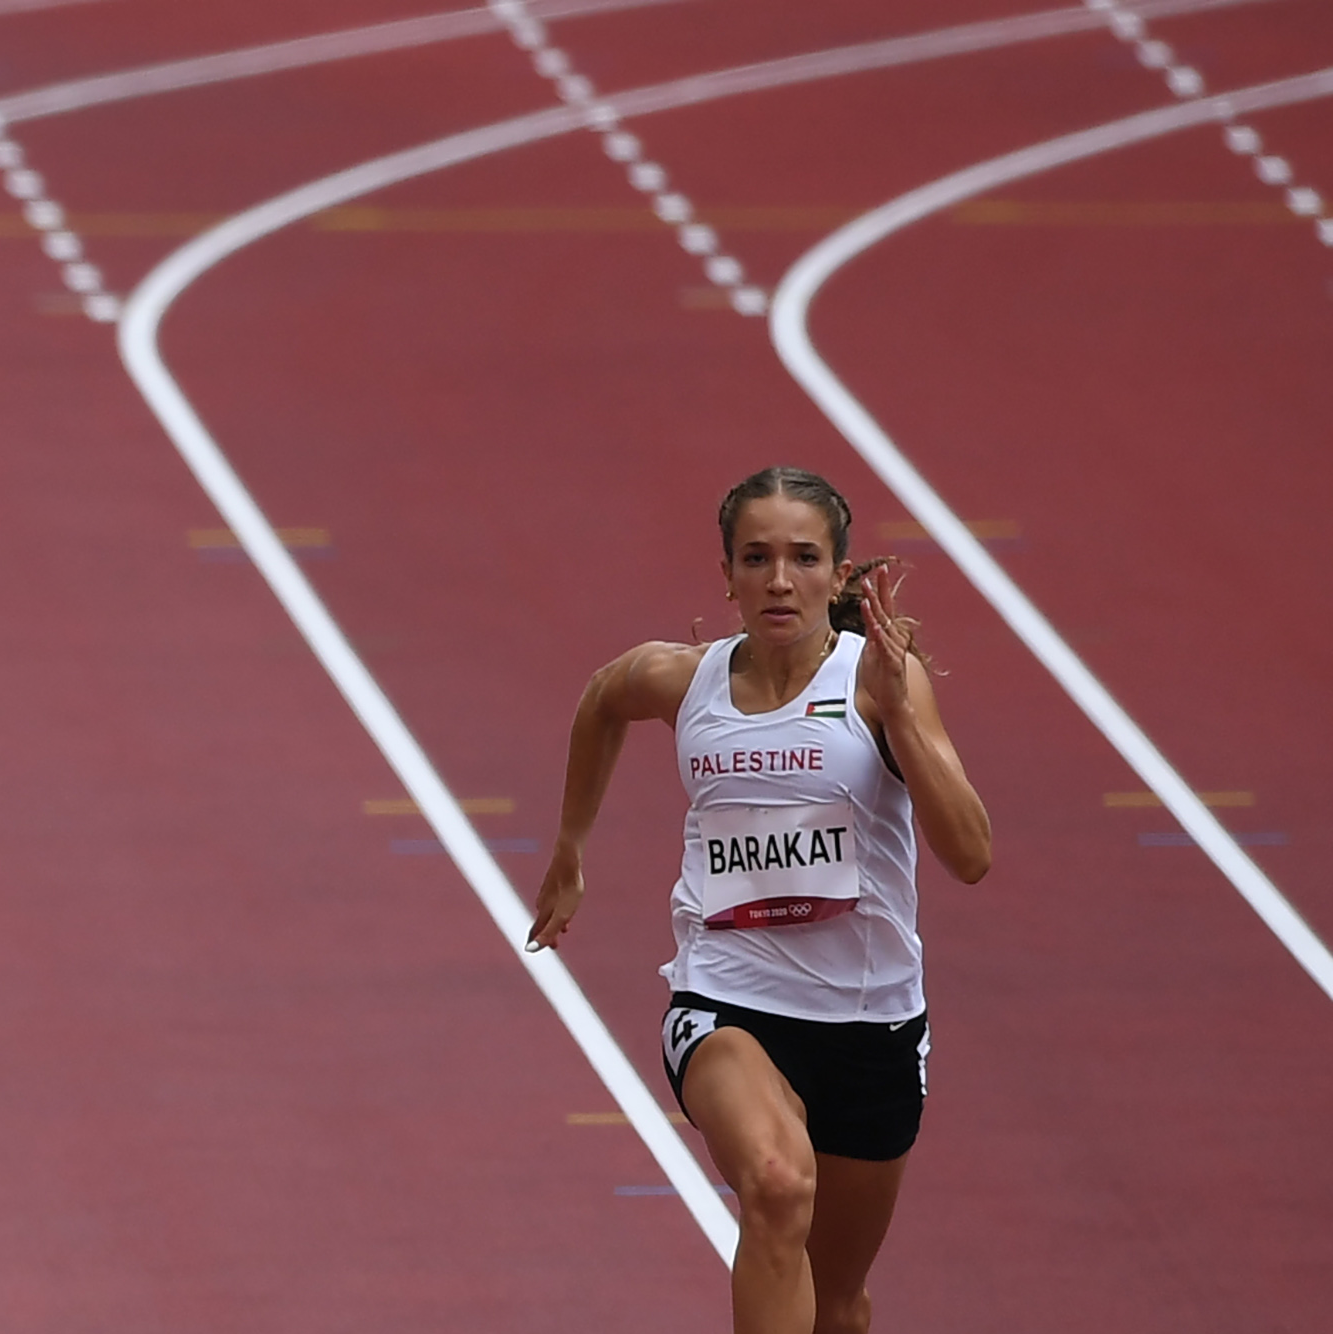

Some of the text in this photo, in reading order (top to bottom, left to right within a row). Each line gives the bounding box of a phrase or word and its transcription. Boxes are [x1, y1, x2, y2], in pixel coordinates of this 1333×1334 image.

[689, 748, 824, 780] PALESTINE
[707, 826, 848, 875] BARAKAT
[671, 1009, 699, 1052] 4
